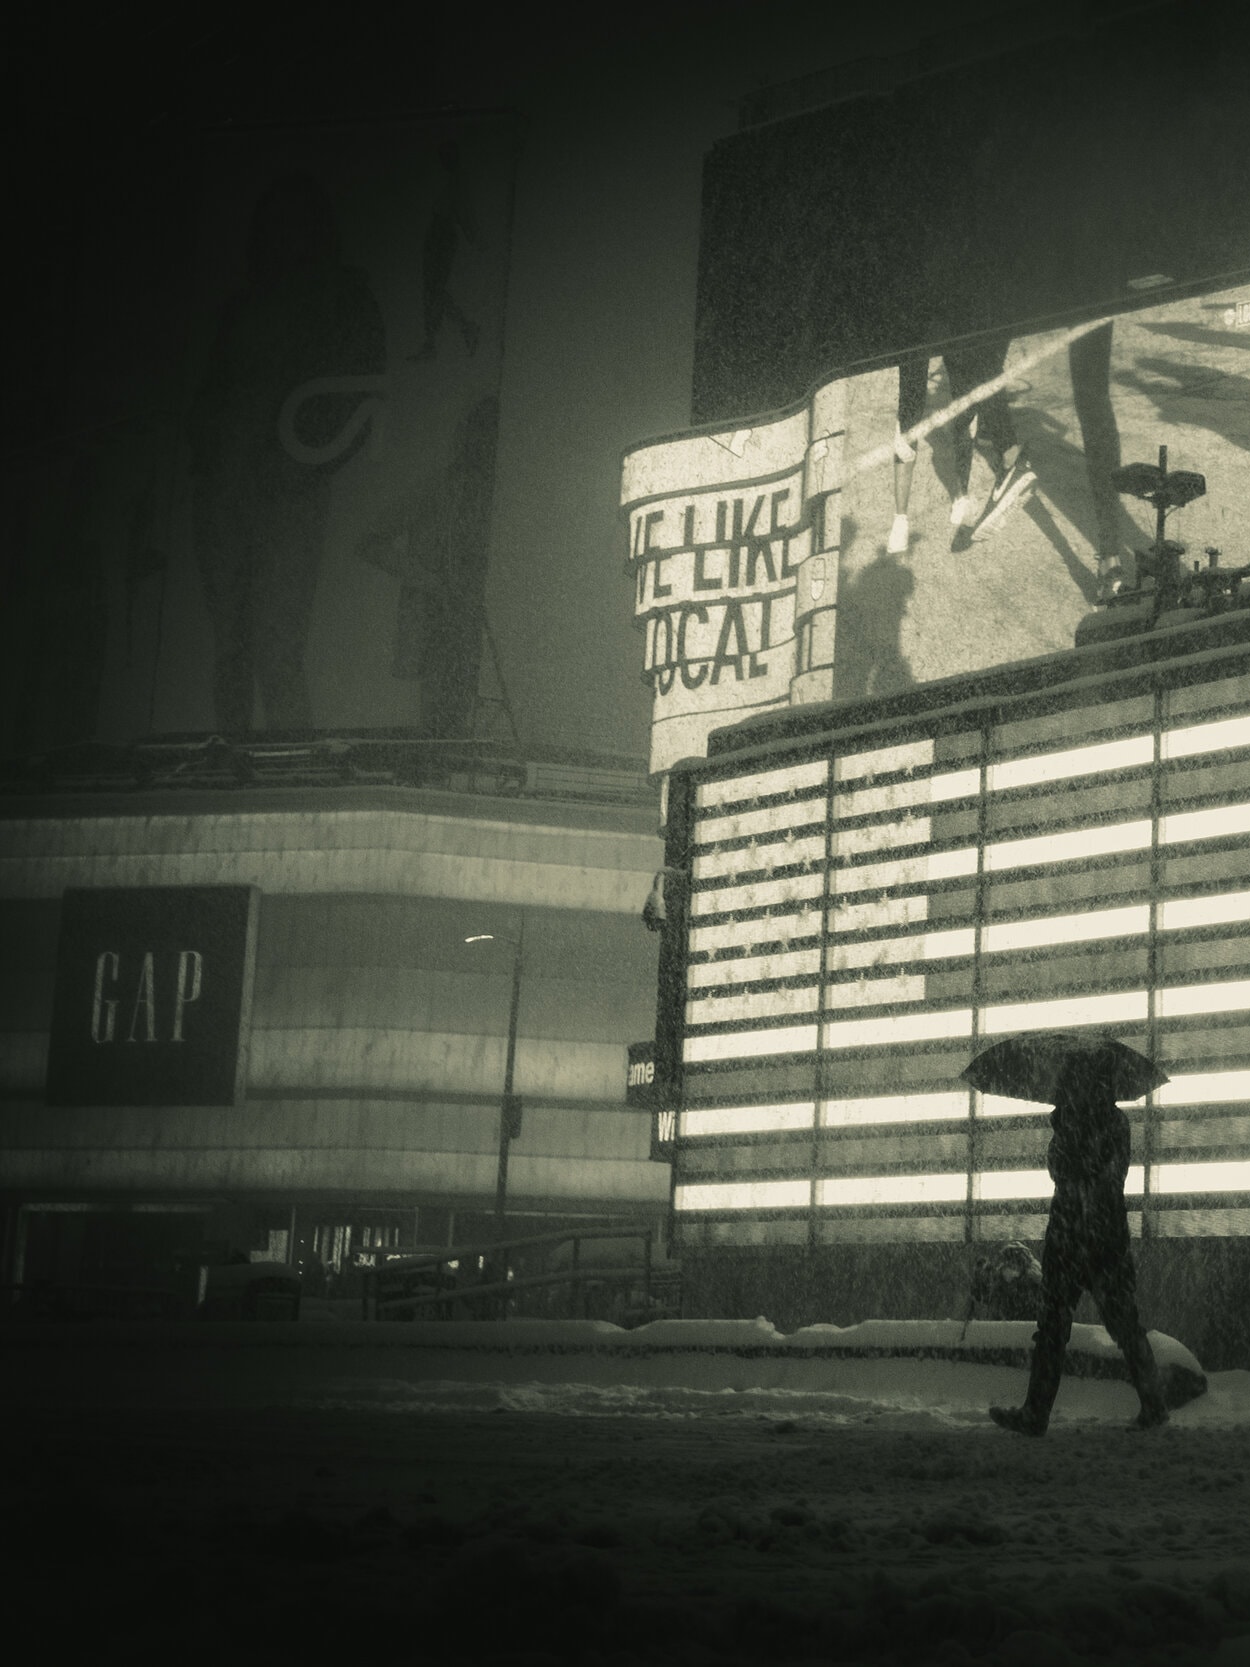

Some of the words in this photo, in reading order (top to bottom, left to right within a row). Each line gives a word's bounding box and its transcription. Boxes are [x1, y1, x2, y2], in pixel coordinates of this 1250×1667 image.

[683, 487, 797, 592] LIKE
[653, 599, 768, 696] OCAL
[91, 950, 203, 1044] GAP
